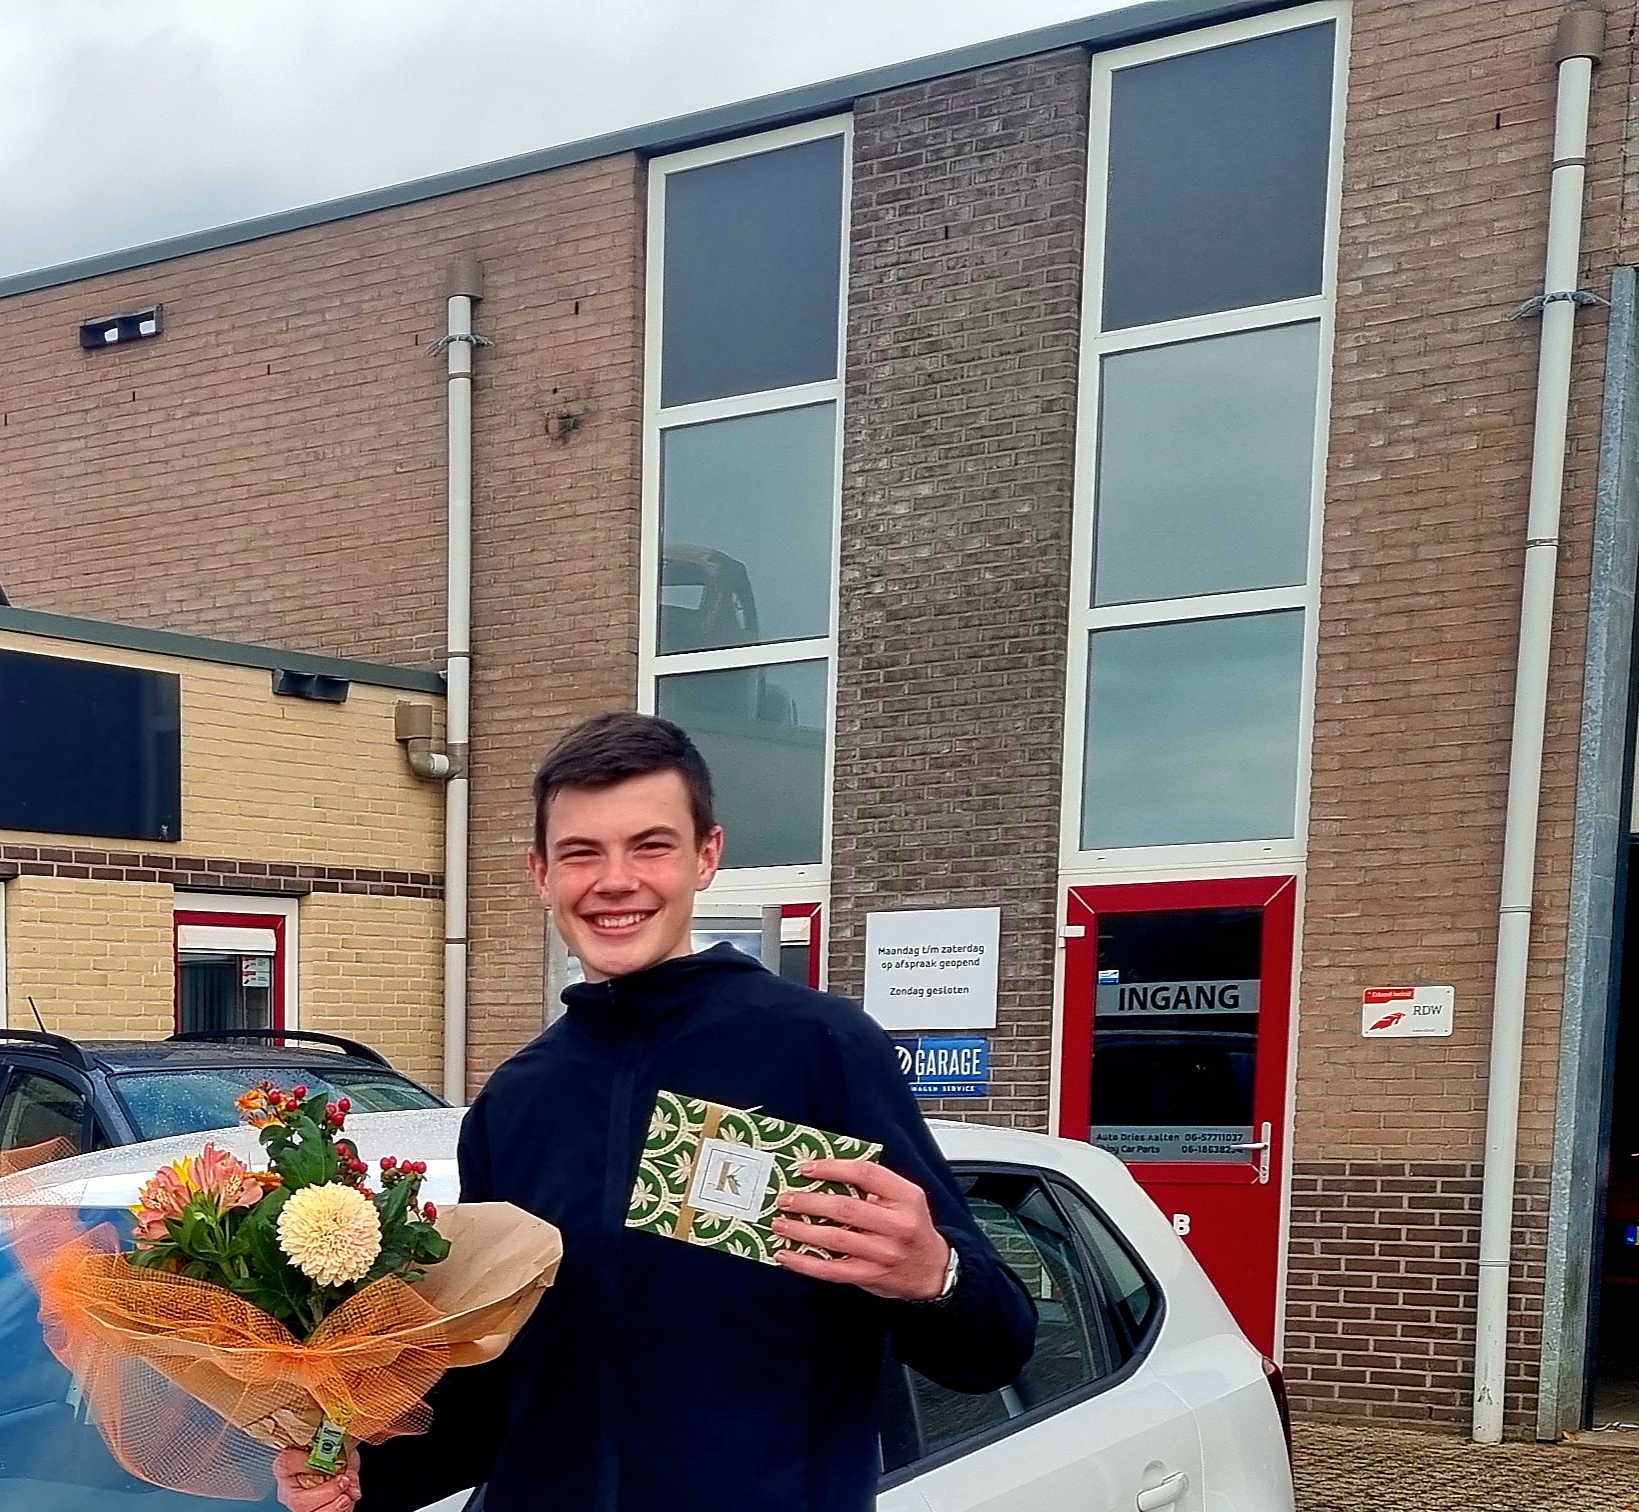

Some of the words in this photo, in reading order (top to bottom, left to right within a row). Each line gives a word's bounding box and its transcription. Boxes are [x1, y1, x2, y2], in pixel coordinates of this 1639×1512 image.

[878, 945, 920, 957] Maandag
[922, 944, 939, 954] t/m
[941, 943, 985, 955] zaterdag
[881, 961, 893, 971] op
[895, 959, 937, 970] afspraak
[939, 957, 981, 969] geopend
[889, 986, 924, 997] Zondag
[926, 985, 970, 997] gesloten
[1118, 984, 1240, 1011] INGANG
[1412, 1005, 1443, 1015] RDW
[915, 1048, 982, 1076] GARAGE
[1096, 1133, 1119, 1141] Auto
[1121, 1133, 1145, 1141] Dries
[1121, 1144, 1135, 1153] Car
[1137, 1145, 1161, 1154] Parts
[1173, 1213, 1191, 1236] B
